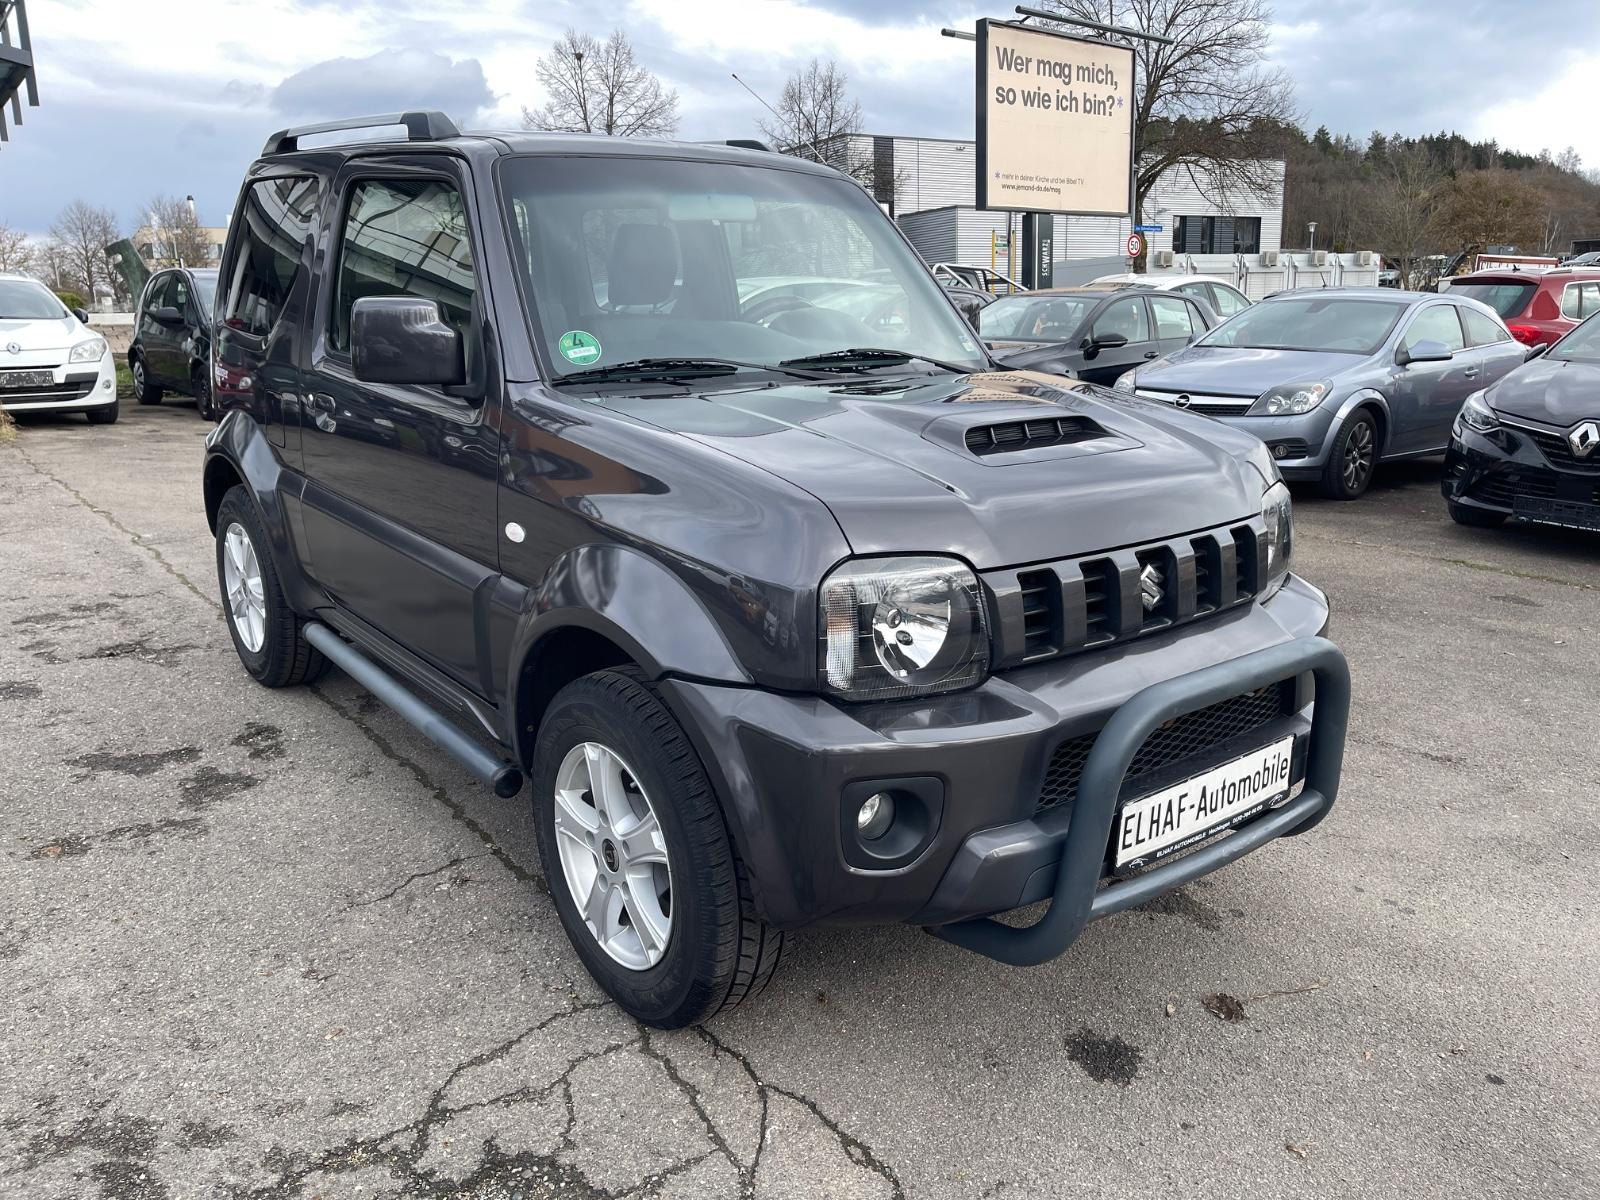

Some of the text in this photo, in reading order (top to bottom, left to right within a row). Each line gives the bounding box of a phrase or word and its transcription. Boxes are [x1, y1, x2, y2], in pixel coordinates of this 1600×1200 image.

[996, 46, 1118, 91] Wer mag mich,
[996, 86, 1016, 105] so
[1021, 86, 1051, 109] wie
[1056, 89, 1079, 112] ich
[1131, 241, 1139, 251] 50
[1042, 243, 1050, 277] SCHWARZ
[573, 333, 584, 347] 4
[1121, 752, 1289, 850] ELHAF-Automobile
[1173, 831, 1207, 851] AUTOMOBILE
